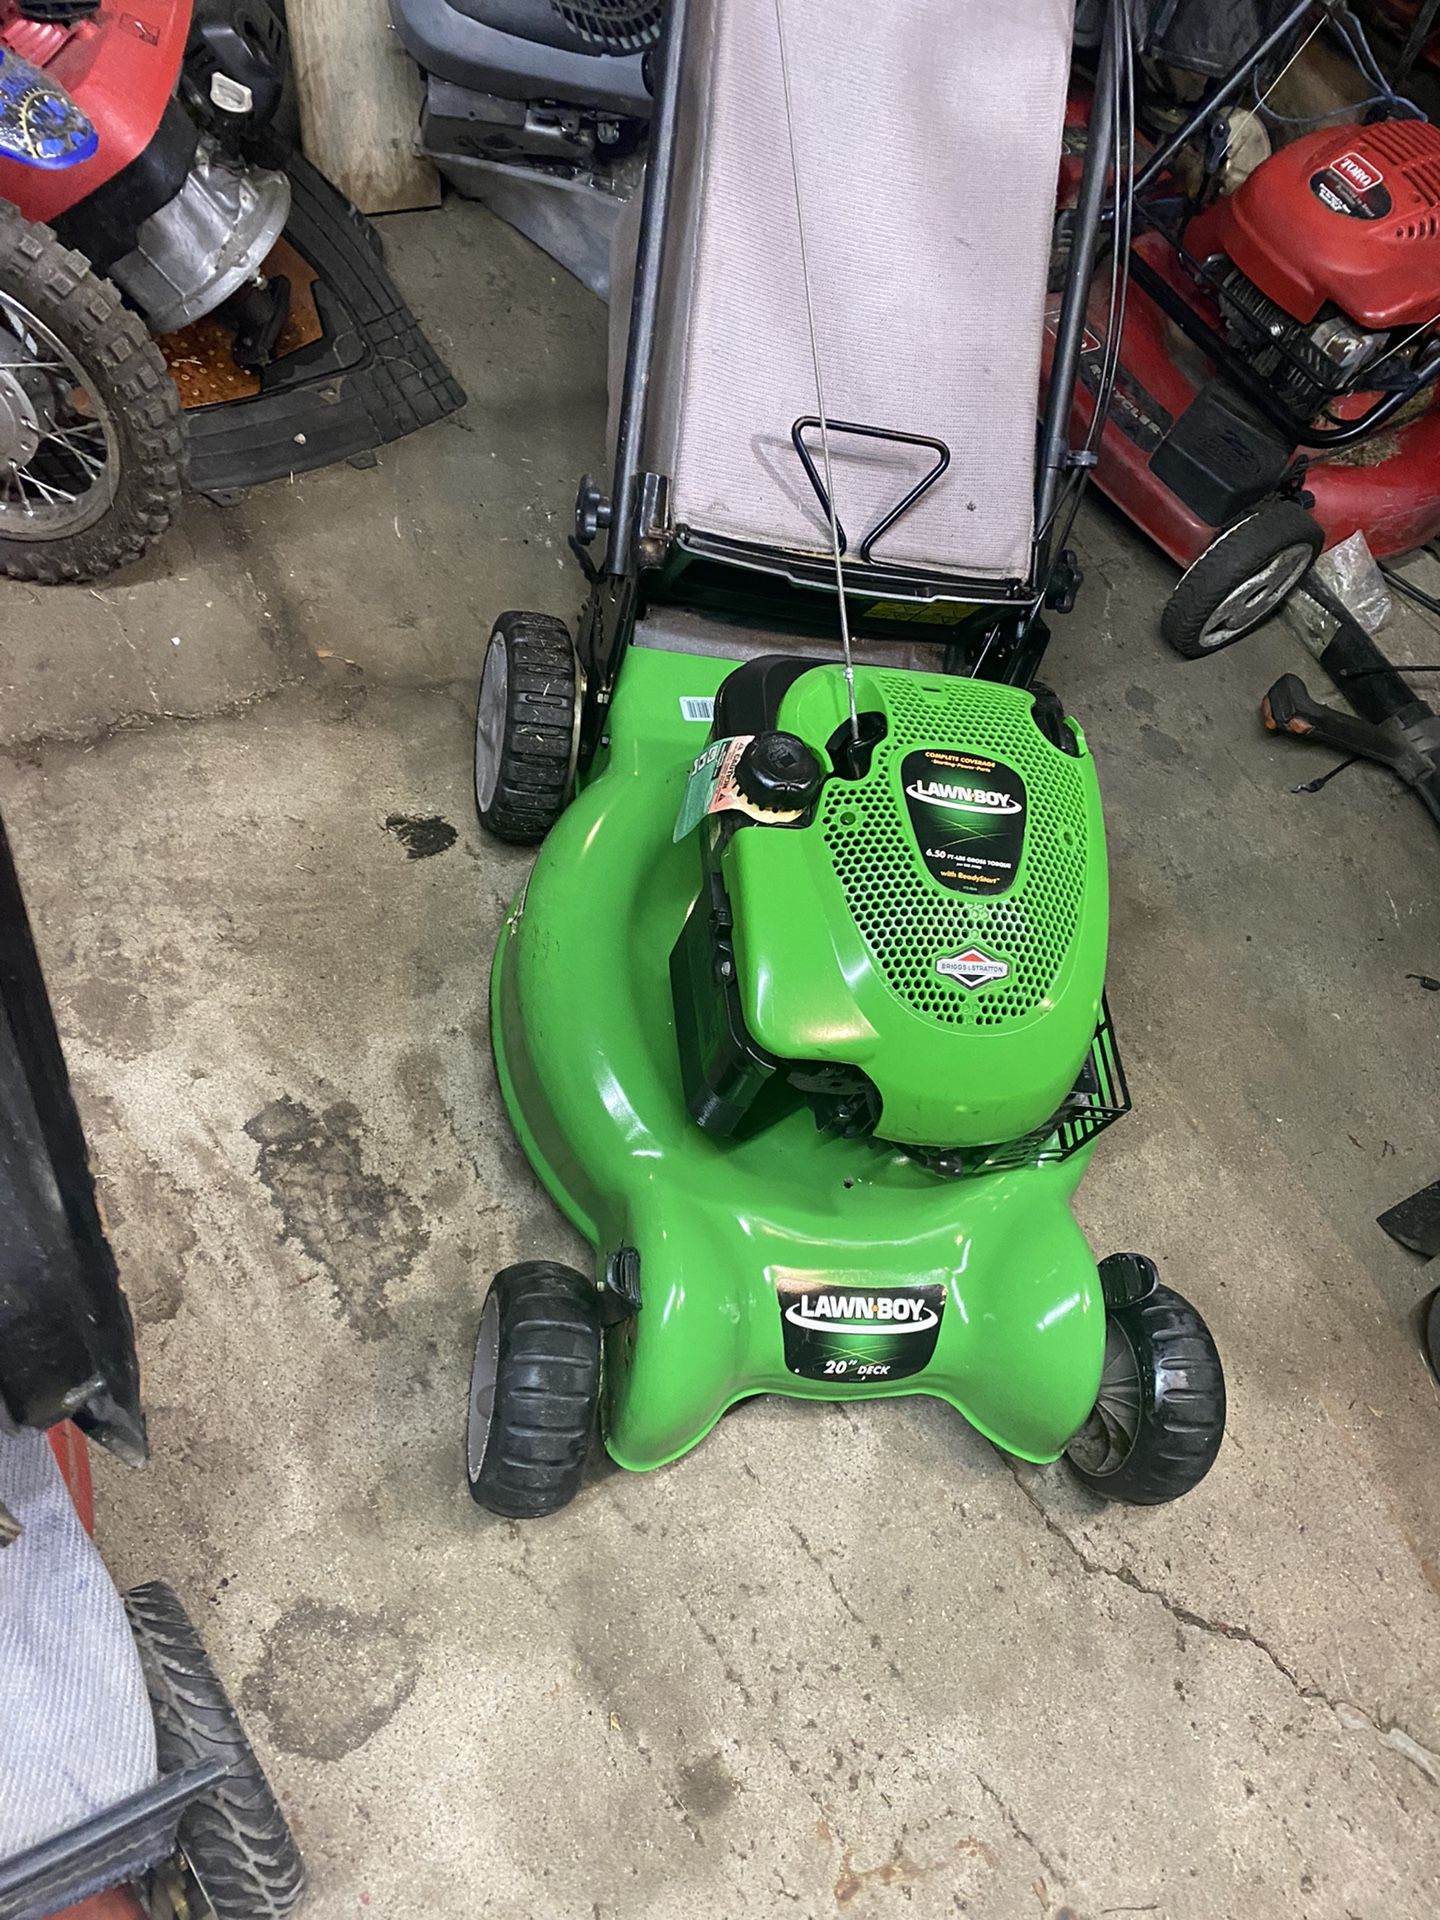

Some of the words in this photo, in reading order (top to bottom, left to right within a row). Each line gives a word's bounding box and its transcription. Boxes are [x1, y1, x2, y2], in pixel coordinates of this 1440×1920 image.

[1341, 158, 1372, 187] TORO
[1089, 364, 1161, 435] RYCLER
[924, 751, 959, 762] COMPLETE
[960, 757, 996, 768] COVERAGE
[925, 848, 946, 859] 6.50
[966, 857, 987, 865] GROSS
[987, 860, 1012, 869] TORQUE
[940, 870, 957, 878] with
[941, 963, 967, 971] BRIGGS
[972, 965, 1004, 973] STRATTON
[857, 1365, 891, 1375] DECK
